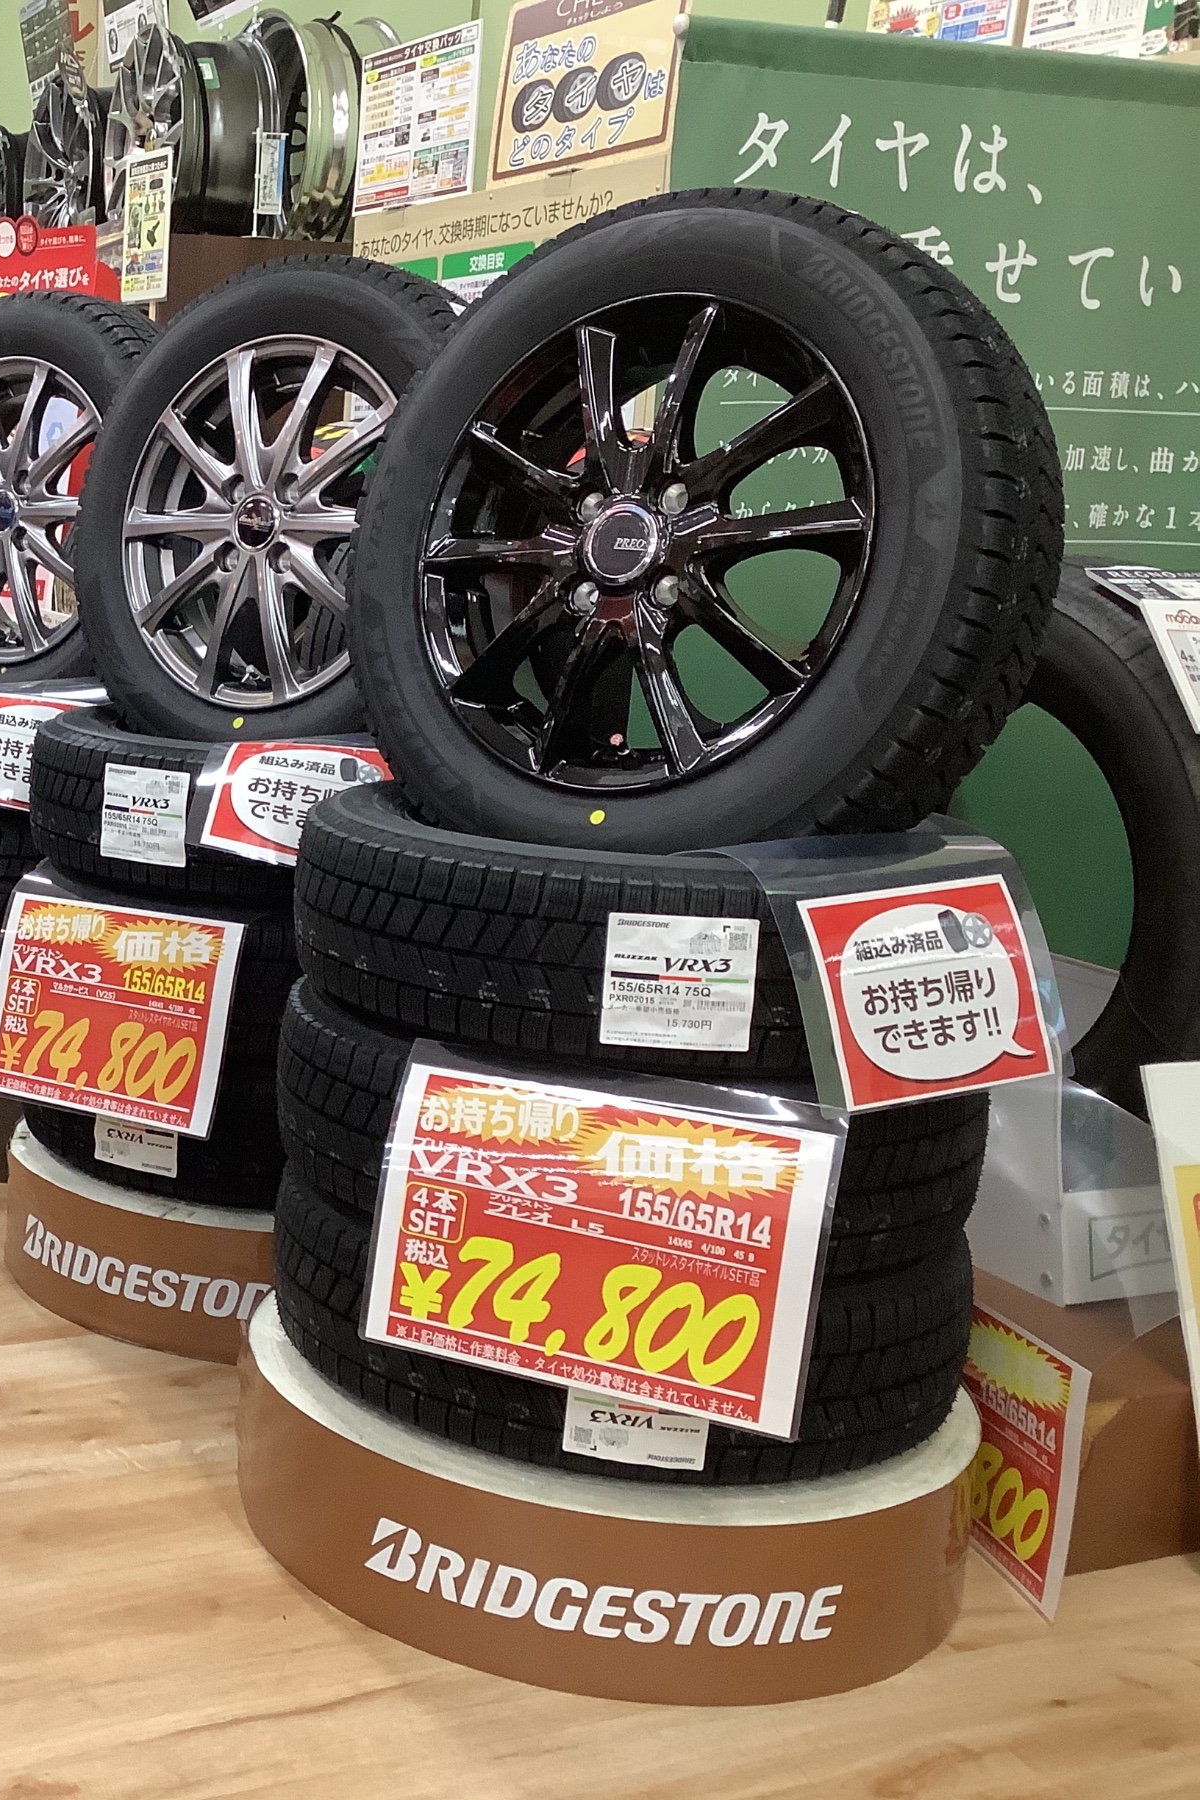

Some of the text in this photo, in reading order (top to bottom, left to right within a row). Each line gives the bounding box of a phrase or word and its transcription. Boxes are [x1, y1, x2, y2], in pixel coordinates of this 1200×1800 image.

[514, 36, 596, 83] あなたの
[524, 61, 666, 126] タイヤは
[509, 106, 636, 168] どのタイプ
[734, 112, 1043, 205] タイヤは、
[469, 251, 505, 273] 交換目安
[806, 254, 937, 450] BRIDGESTONE
[614, 537, 644, 549] PREO
[1107, 570, 1177, 579] REGNO
[259, 754, 336, 776] 組込み済品
[131, 795, 170, 810] VRX3
[104, 811, 158, 826] 155/65R14 75Q
[17, 914, 106, 941] お持ち帰り
[617, 918, 671, 929] BRIDGESTONE
[112, 930, 215, 964] 価格
[853, 930, 944, 961] 組込み済品
[12, 952, 103, 983] VRX3
[613, 953, 732, 973] BLIZZAK VRX3
[10, 980, 37, 996] 4本
[123, 968, 205, 1003] 155/65R14
[609, 993, 655, 1004] PXR02015
[610, 981, 711, 998] 155/65R14 75Q
[861, 967, 996, 1016] お持ち帰り
[7, 996, 35, 1014] SET
[4, 1016, 28, 1035] 税込
[666, 1019, 712, 1030] 15,730円
[420, 1095, 580, 1142] お持ち帰り
[106, 1127, 144, 1144] VRX3
[596, 1131, 786, 1190] 価格
[413, 1150, 578, 1203] VRX3
[412, 1187, 458, 1213] 4本
[408, 1209, 457, 1239] SET
[487, 1201, 605, 1235] プレオ L5
[618, 1187, 772, 1249] 155/65R14
[404, 1240, 450, 1269] 税込
[668, 1235, 693, 1249] 14X45
[701, 1242, 725, 1257] 4/100
[733, 1248, 744, 1260] 45
[590, 1409, 656, 1431] VRX3
[646, 1451, 696, 1466] BRIDGESTONE
[363, 1517, 844, 1647] BRIDGESTONE
